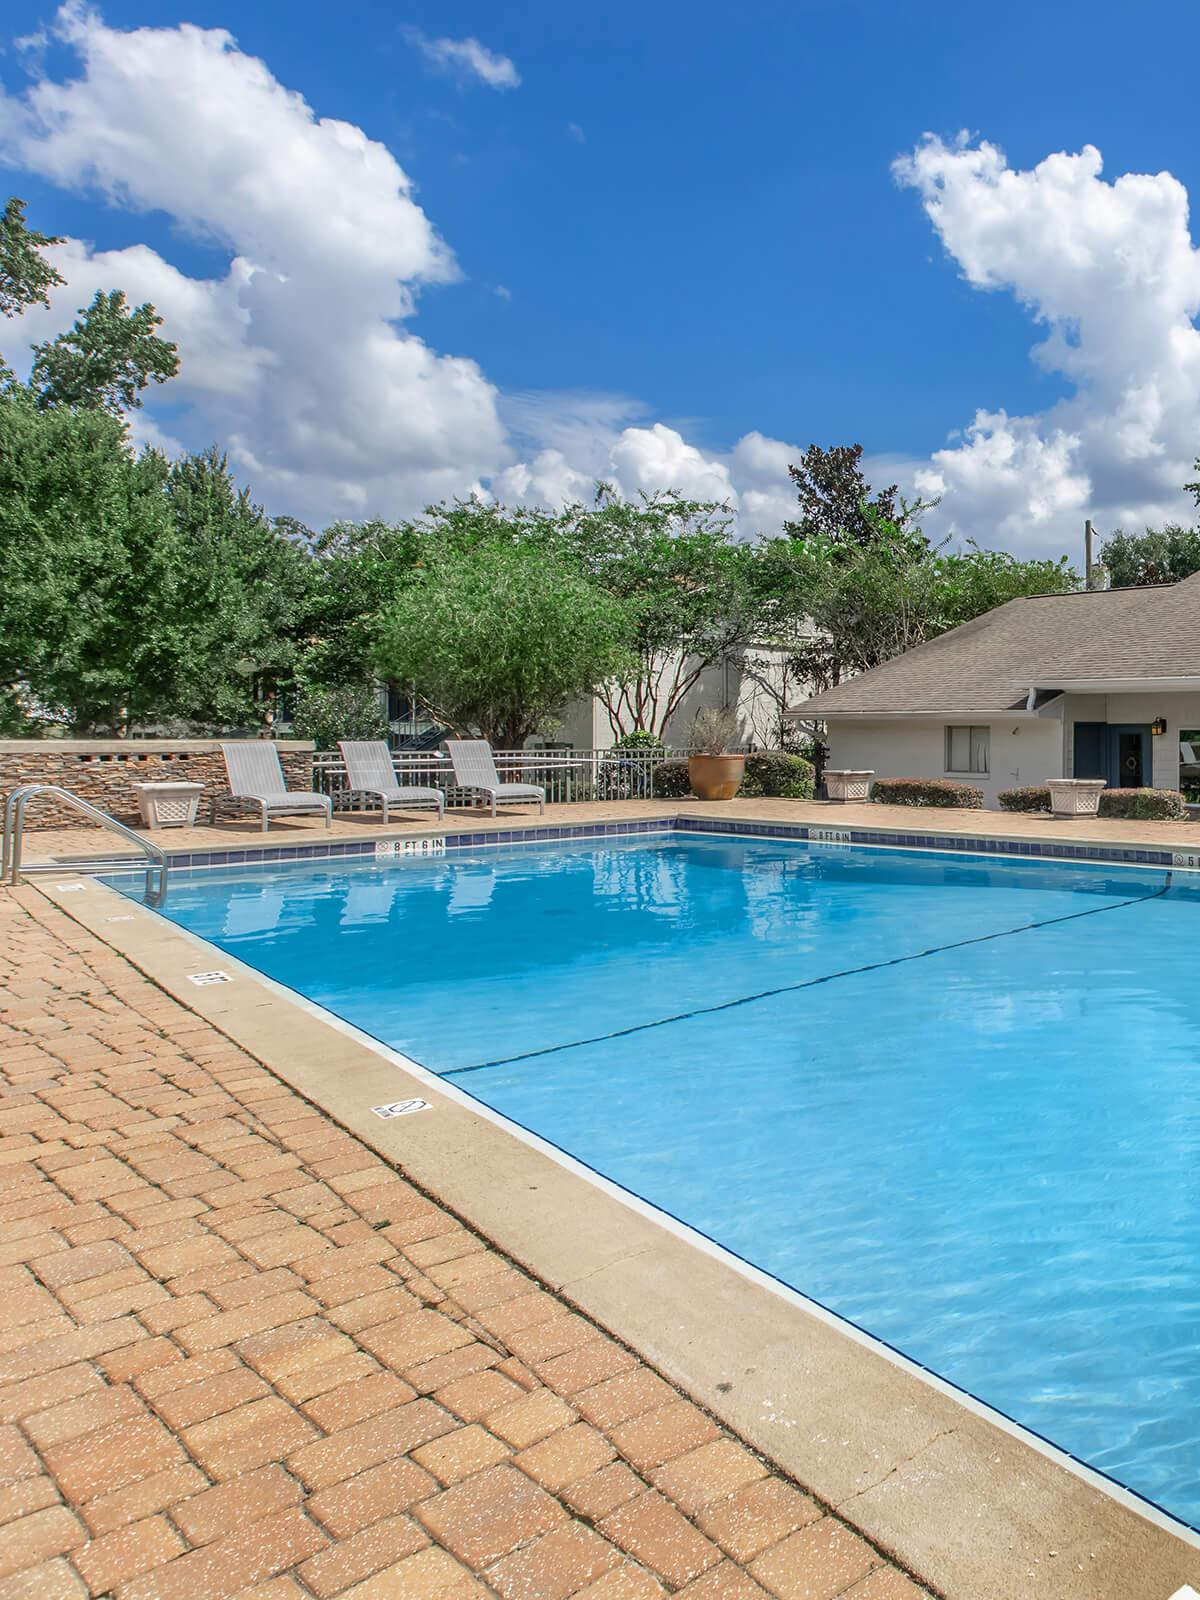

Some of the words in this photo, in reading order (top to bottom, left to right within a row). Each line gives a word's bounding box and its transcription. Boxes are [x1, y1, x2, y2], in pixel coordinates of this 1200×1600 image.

[394, 842, 401, 851] 8
[405, 841, 417, 850] FT
[422, 840, 429, 849] 6
[432, 839, 443, 849] IN
[1188, 856, 1194, 867] 5
